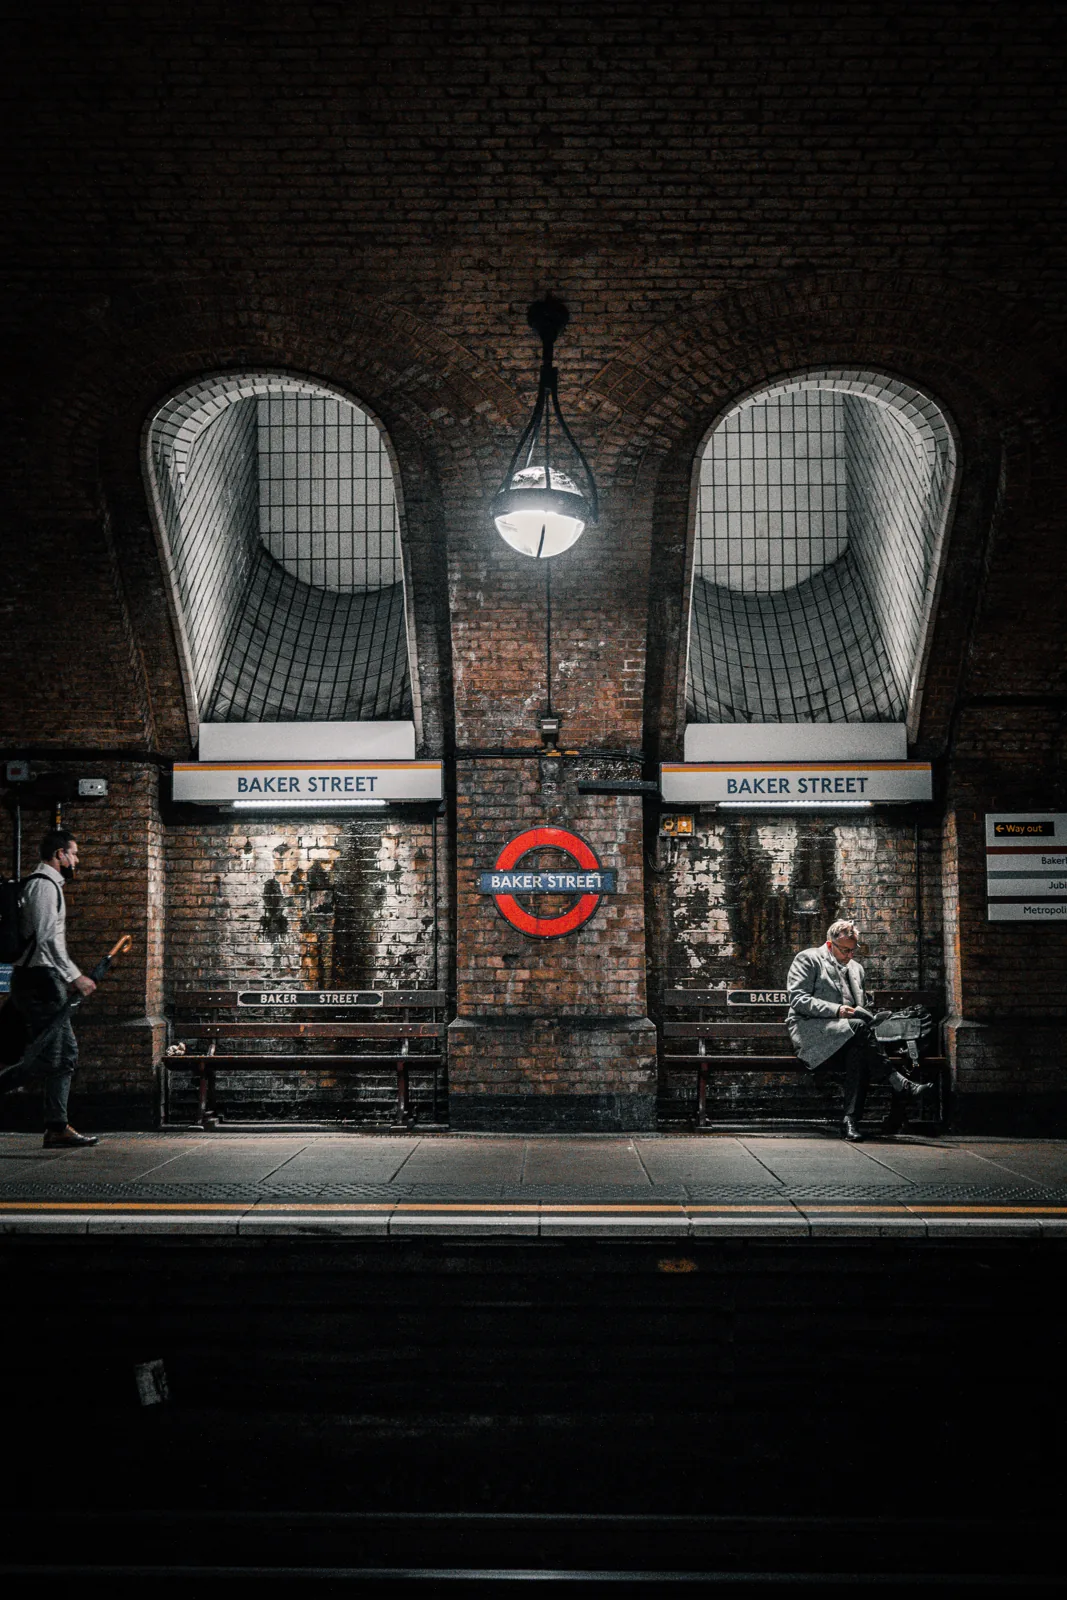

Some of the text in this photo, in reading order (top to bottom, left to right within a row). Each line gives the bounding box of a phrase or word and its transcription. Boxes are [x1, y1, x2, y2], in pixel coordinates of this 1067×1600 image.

[237, 776, 378, 793] BAKER STREET
[727, 777, 868, 794] BAKER STREET
[1006, 824, 1043, 835] Way out
[491, 875, 604, 888] BAKER STREET
[1048, 881, 1067, 890] Jubi
[1023, 905, 1067, 915] Metropoli
[260, 993, 359, 1004] BAKER STREET
[750, 993, 787, 1003] BAKER
